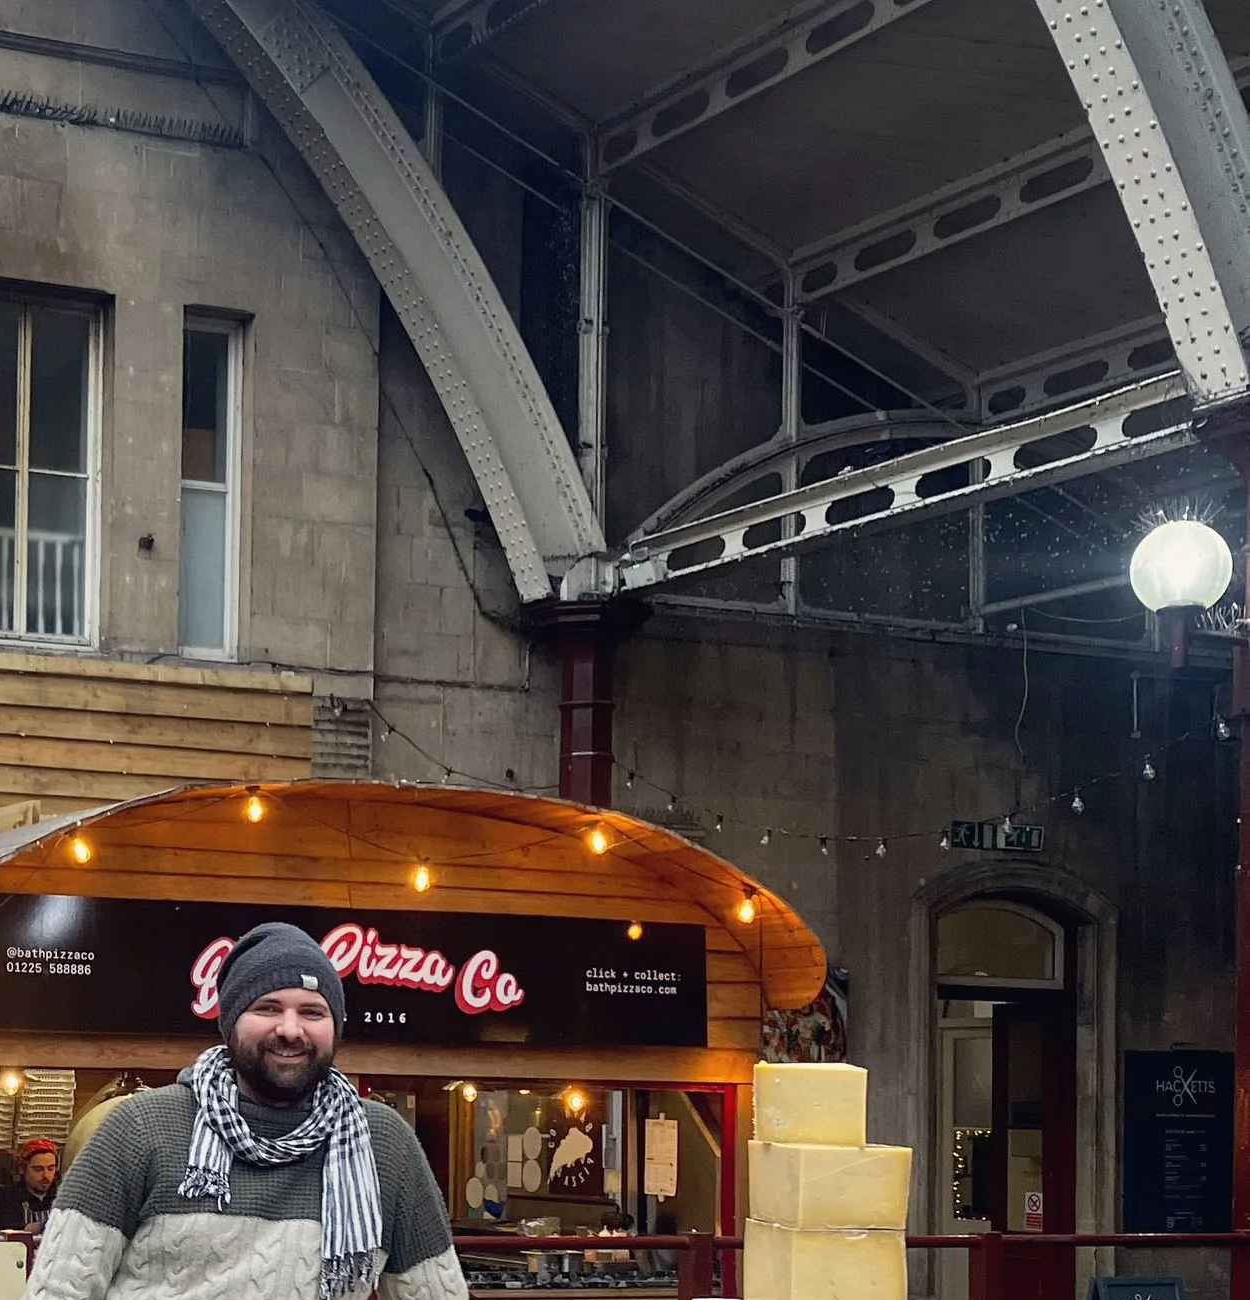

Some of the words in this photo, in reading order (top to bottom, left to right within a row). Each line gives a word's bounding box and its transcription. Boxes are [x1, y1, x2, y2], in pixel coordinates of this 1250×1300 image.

[6, 947, 95, 961] @bathpizzaco
[6, 962, 42, 973] 01225
[49, 963, 91, 975] 588886
[320, 924, 454, 992] Pizza
[458, 949, 524, 1012] Co
[586, 967, 616, 979] click
[634, 970, 681, 981] collect:
[586, 981, 677, 995] bathpizzaco.com
[364, 1012, 407, 1024] 2016
